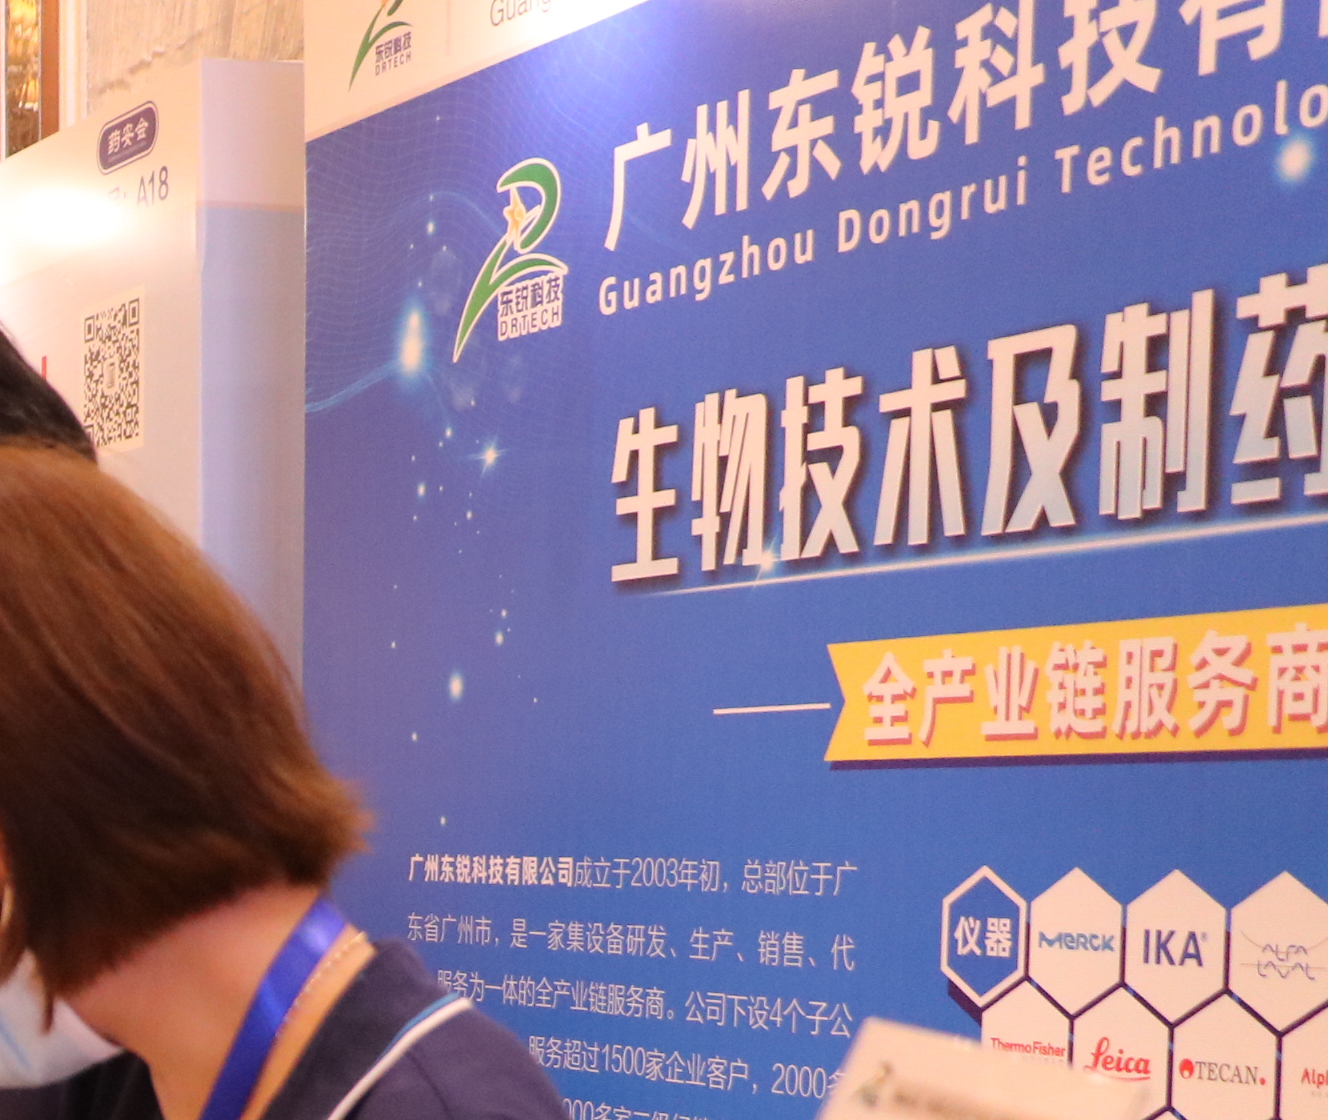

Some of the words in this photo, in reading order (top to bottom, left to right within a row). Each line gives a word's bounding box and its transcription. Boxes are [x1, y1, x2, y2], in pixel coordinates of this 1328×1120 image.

[375, 31, 412, 64] 东锐科技
[375, 51, 412, 77] DRTECH
[107, 117, 148, 155] 药安会
[604, 0, 1328, 252] 广州东锐科技有
[137, 165, 169, 207] A18
[598, 226, 815, 316] Guangzhou
[837, 157, 1028, 253] Dongrui
[500, 276, 561, 318] 东锐科技
[500, 306, 560, 337] DRTECH
[612, 264, 1328, 584] 生物技术及制药
[862, 622, 1328, 744] 全产业链服务商
[953, 916, 1013, 958] 仪器
[1085, 1036, 1151, 1076] Leica
[1301, 1067, 1328, 1089] Alp
